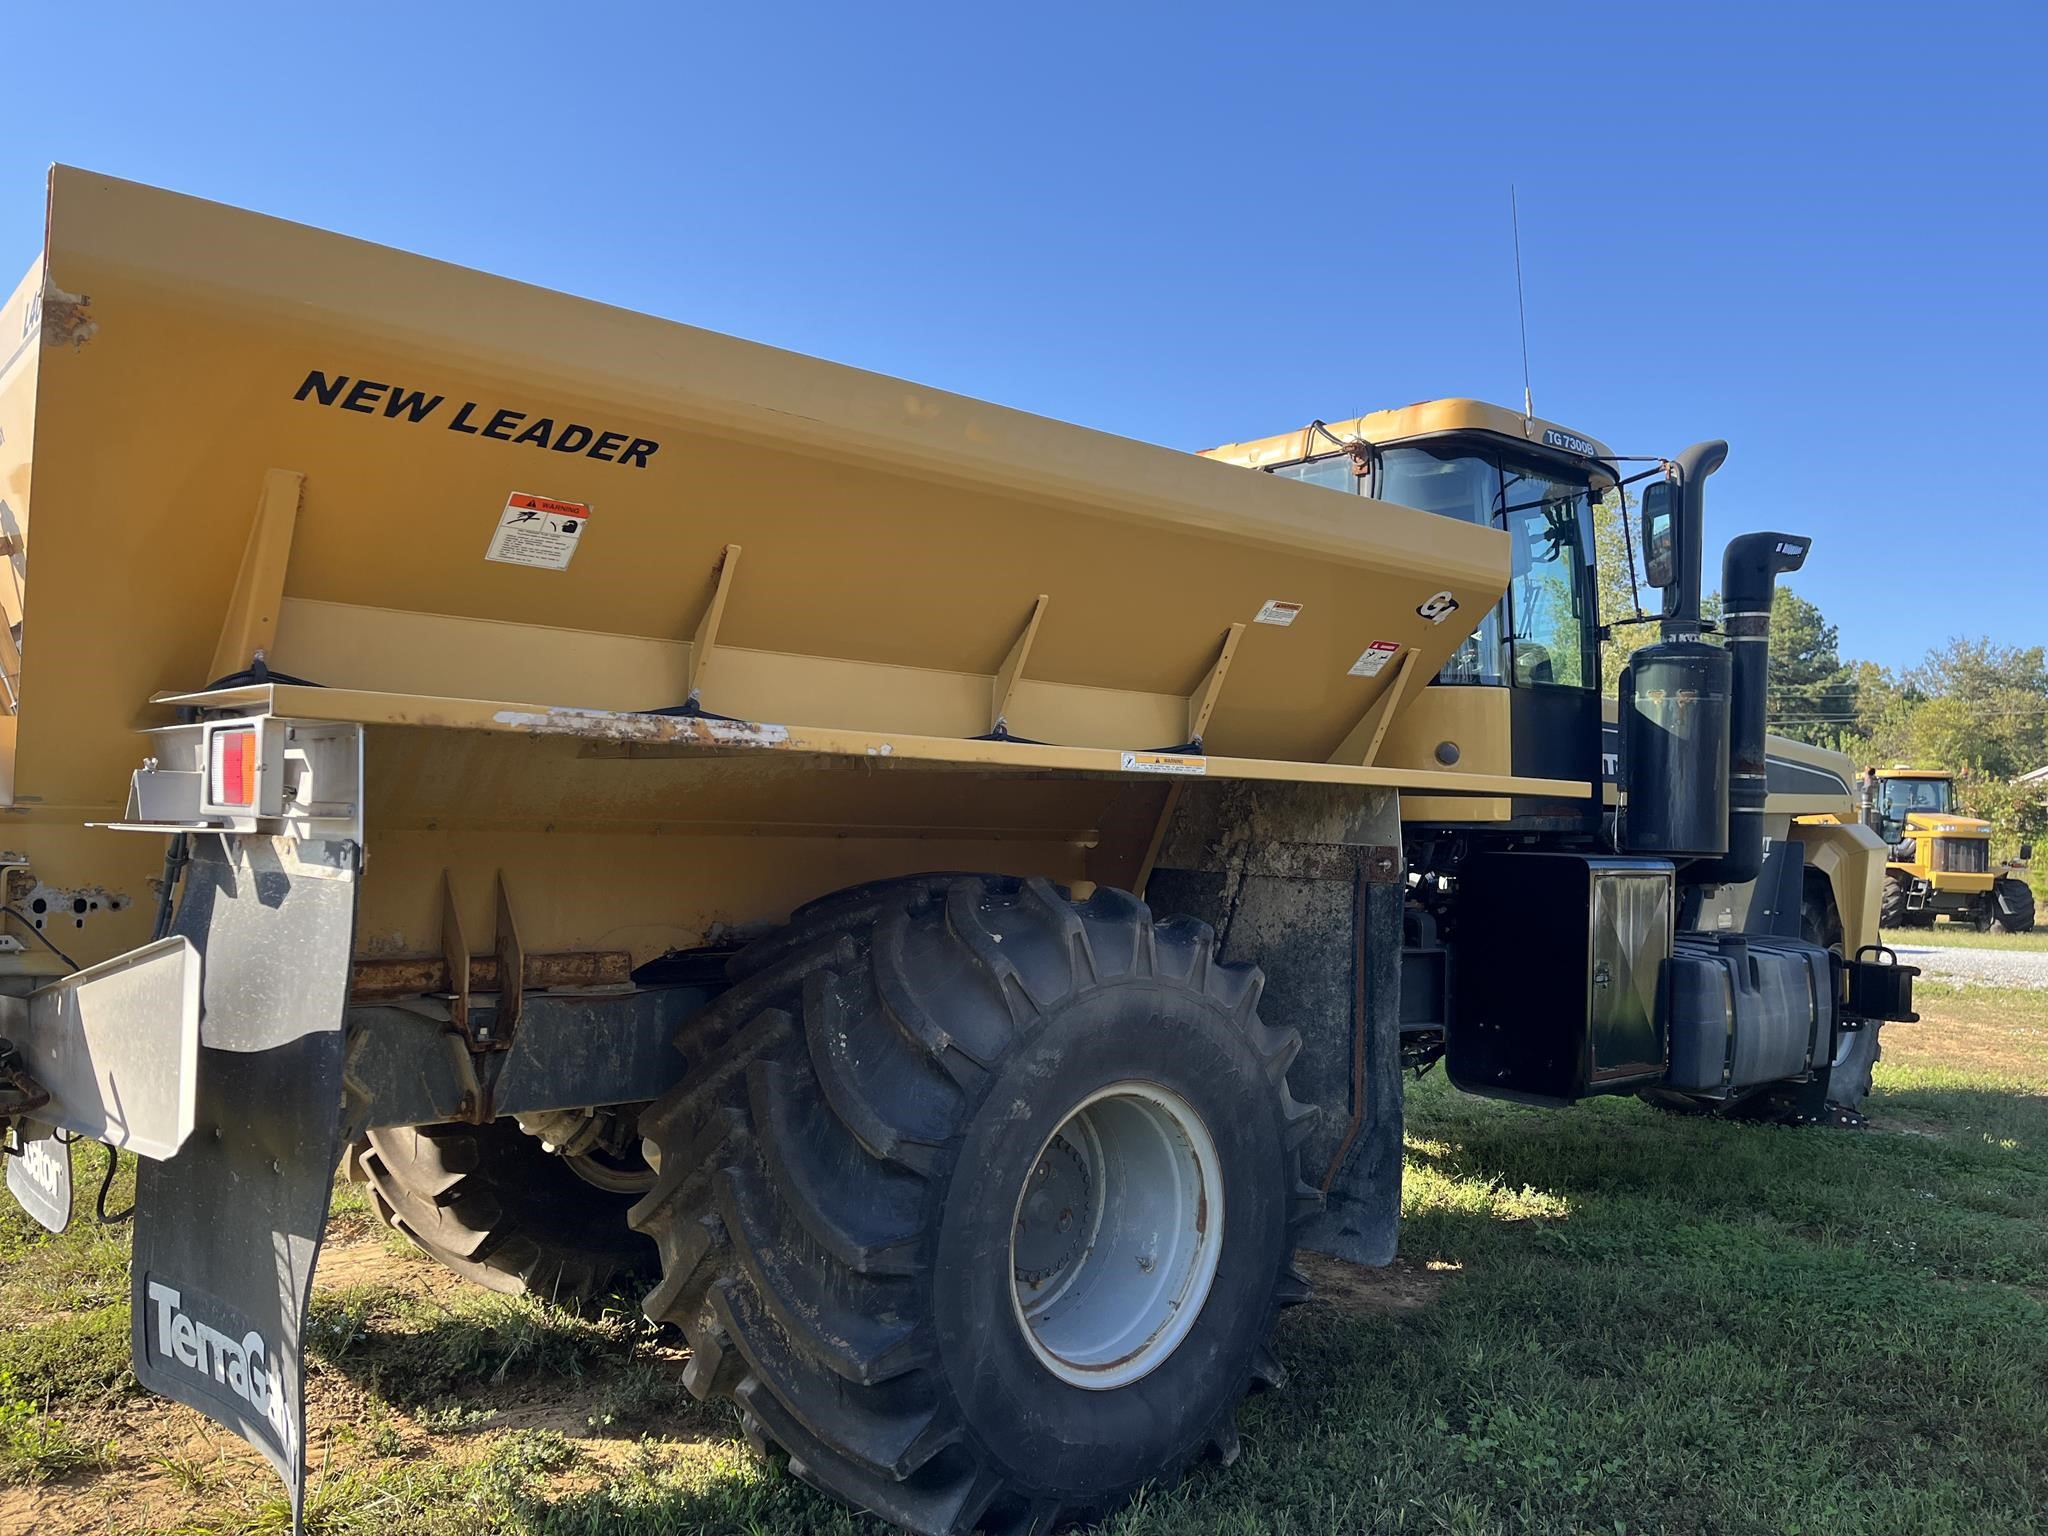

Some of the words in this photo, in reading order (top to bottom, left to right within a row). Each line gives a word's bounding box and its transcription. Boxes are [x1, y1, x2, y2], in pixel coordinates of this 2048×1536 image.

[293, 370, 445, 423] NEW
[448, 402, 660, 469] LEADER
[1547, 430, 1562, 446] TG
[1563, 435, 1595, 456] 7300B
[541, 501, 580, 515] WARNING
